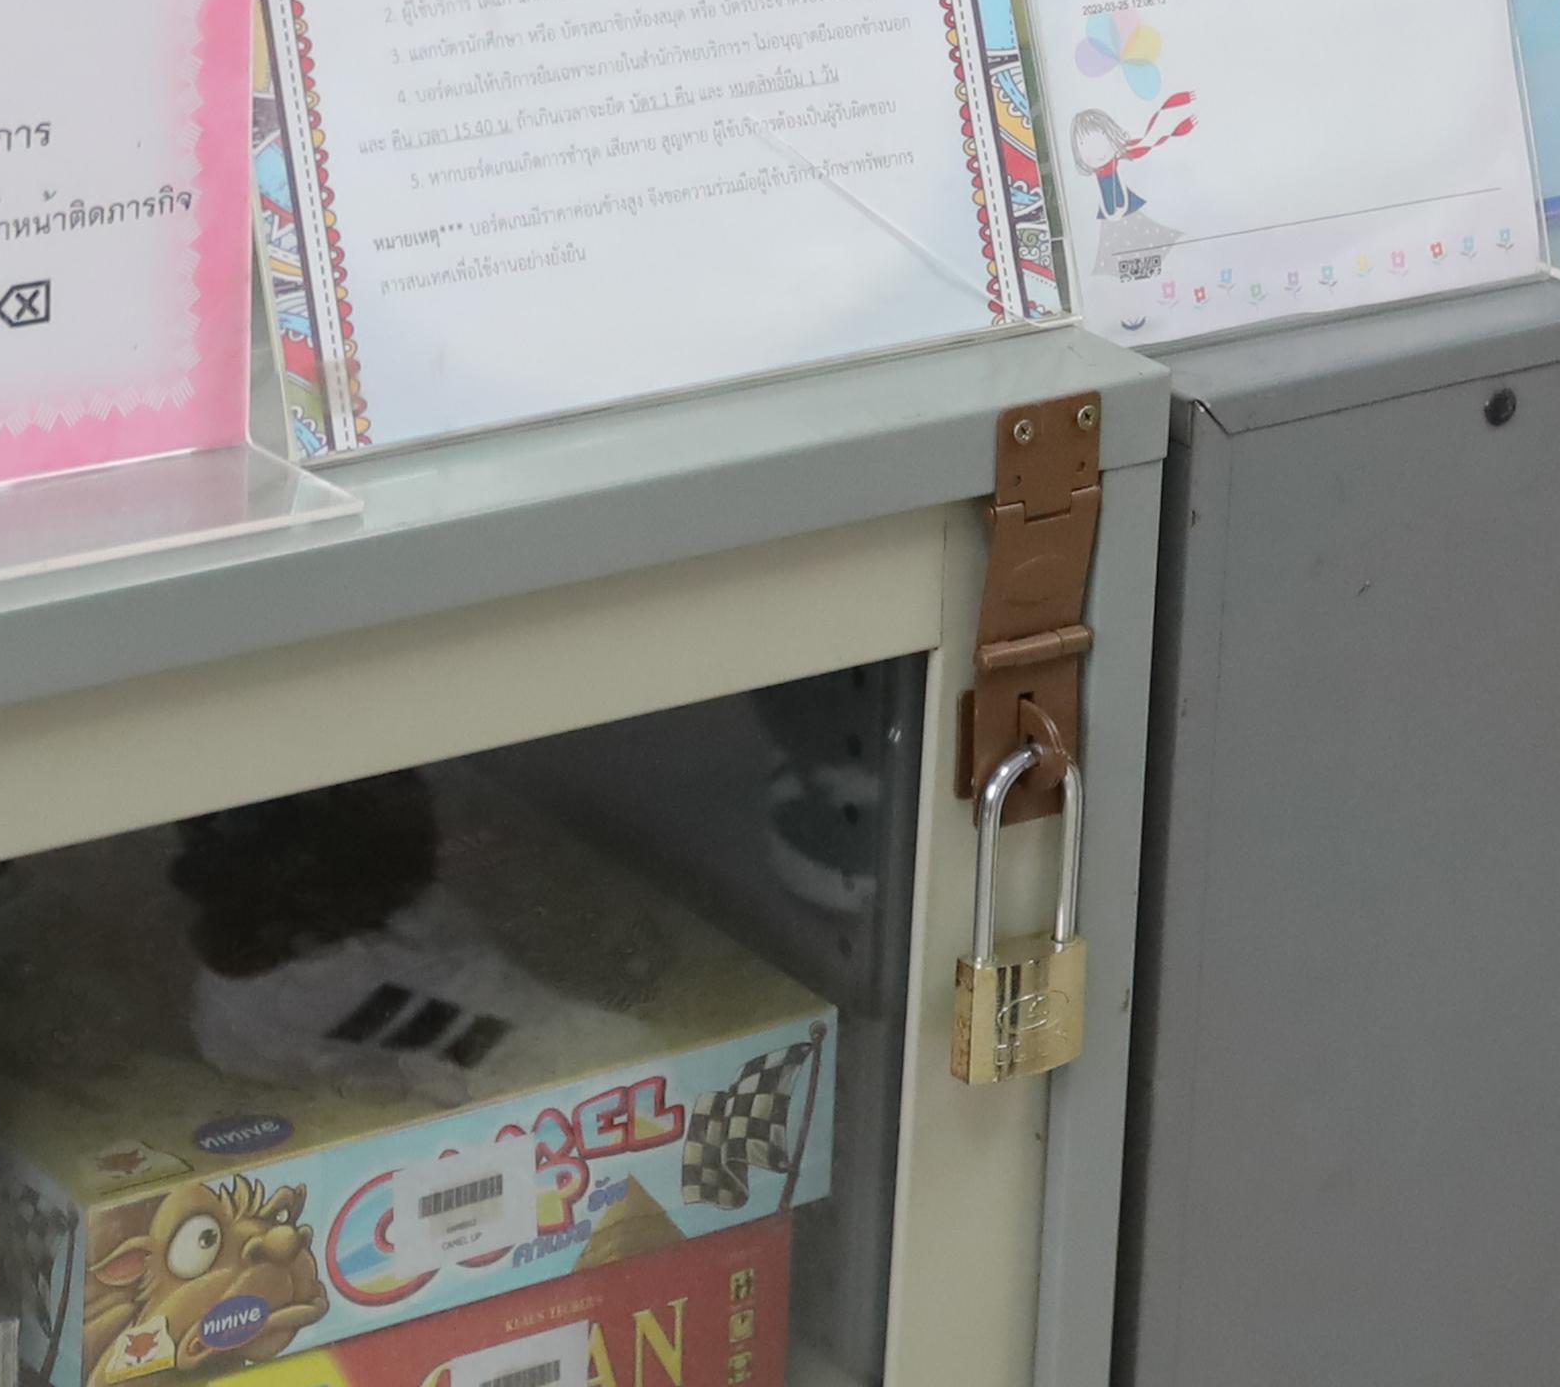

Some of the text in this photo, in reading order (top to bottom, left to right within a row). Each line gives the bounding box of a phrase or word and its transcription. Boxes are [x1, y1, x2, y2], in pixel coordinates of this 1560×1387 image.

[383, 6, 393, 23] 2.
[391, 47, 401, 65] 3.
[408, 31, 521, 63] แลกบัตรนักศึกษา
[528, 23, 555, 44] หรือ
[562, 6, 684, 38] บัตรสมาชิกห้องสมุด
[691, 0, 715, 19] หรือ
[359, 137, 385, 156] และ
[391, 130, 410, 151] คืน
[418, 127, 446, 147] เวลา
[454, 119, 492, 141] 15.40
[630, 93, 656, 113] บัตร
[674, 87, 694, 105] คืน
[699, 84, 722, 101] และ
[823, 63, 838, 84] วัน
[410, 172, 423, 190] 5.
[606, 137, 656, 158] เสียหาย
[662, 130, 707, 154] สูญหาย
[200, 1120, 279, 1148] ninive
[203, 1306, 262, 1336] ninive
[504, 1308, 547, 1333] KLAUS
